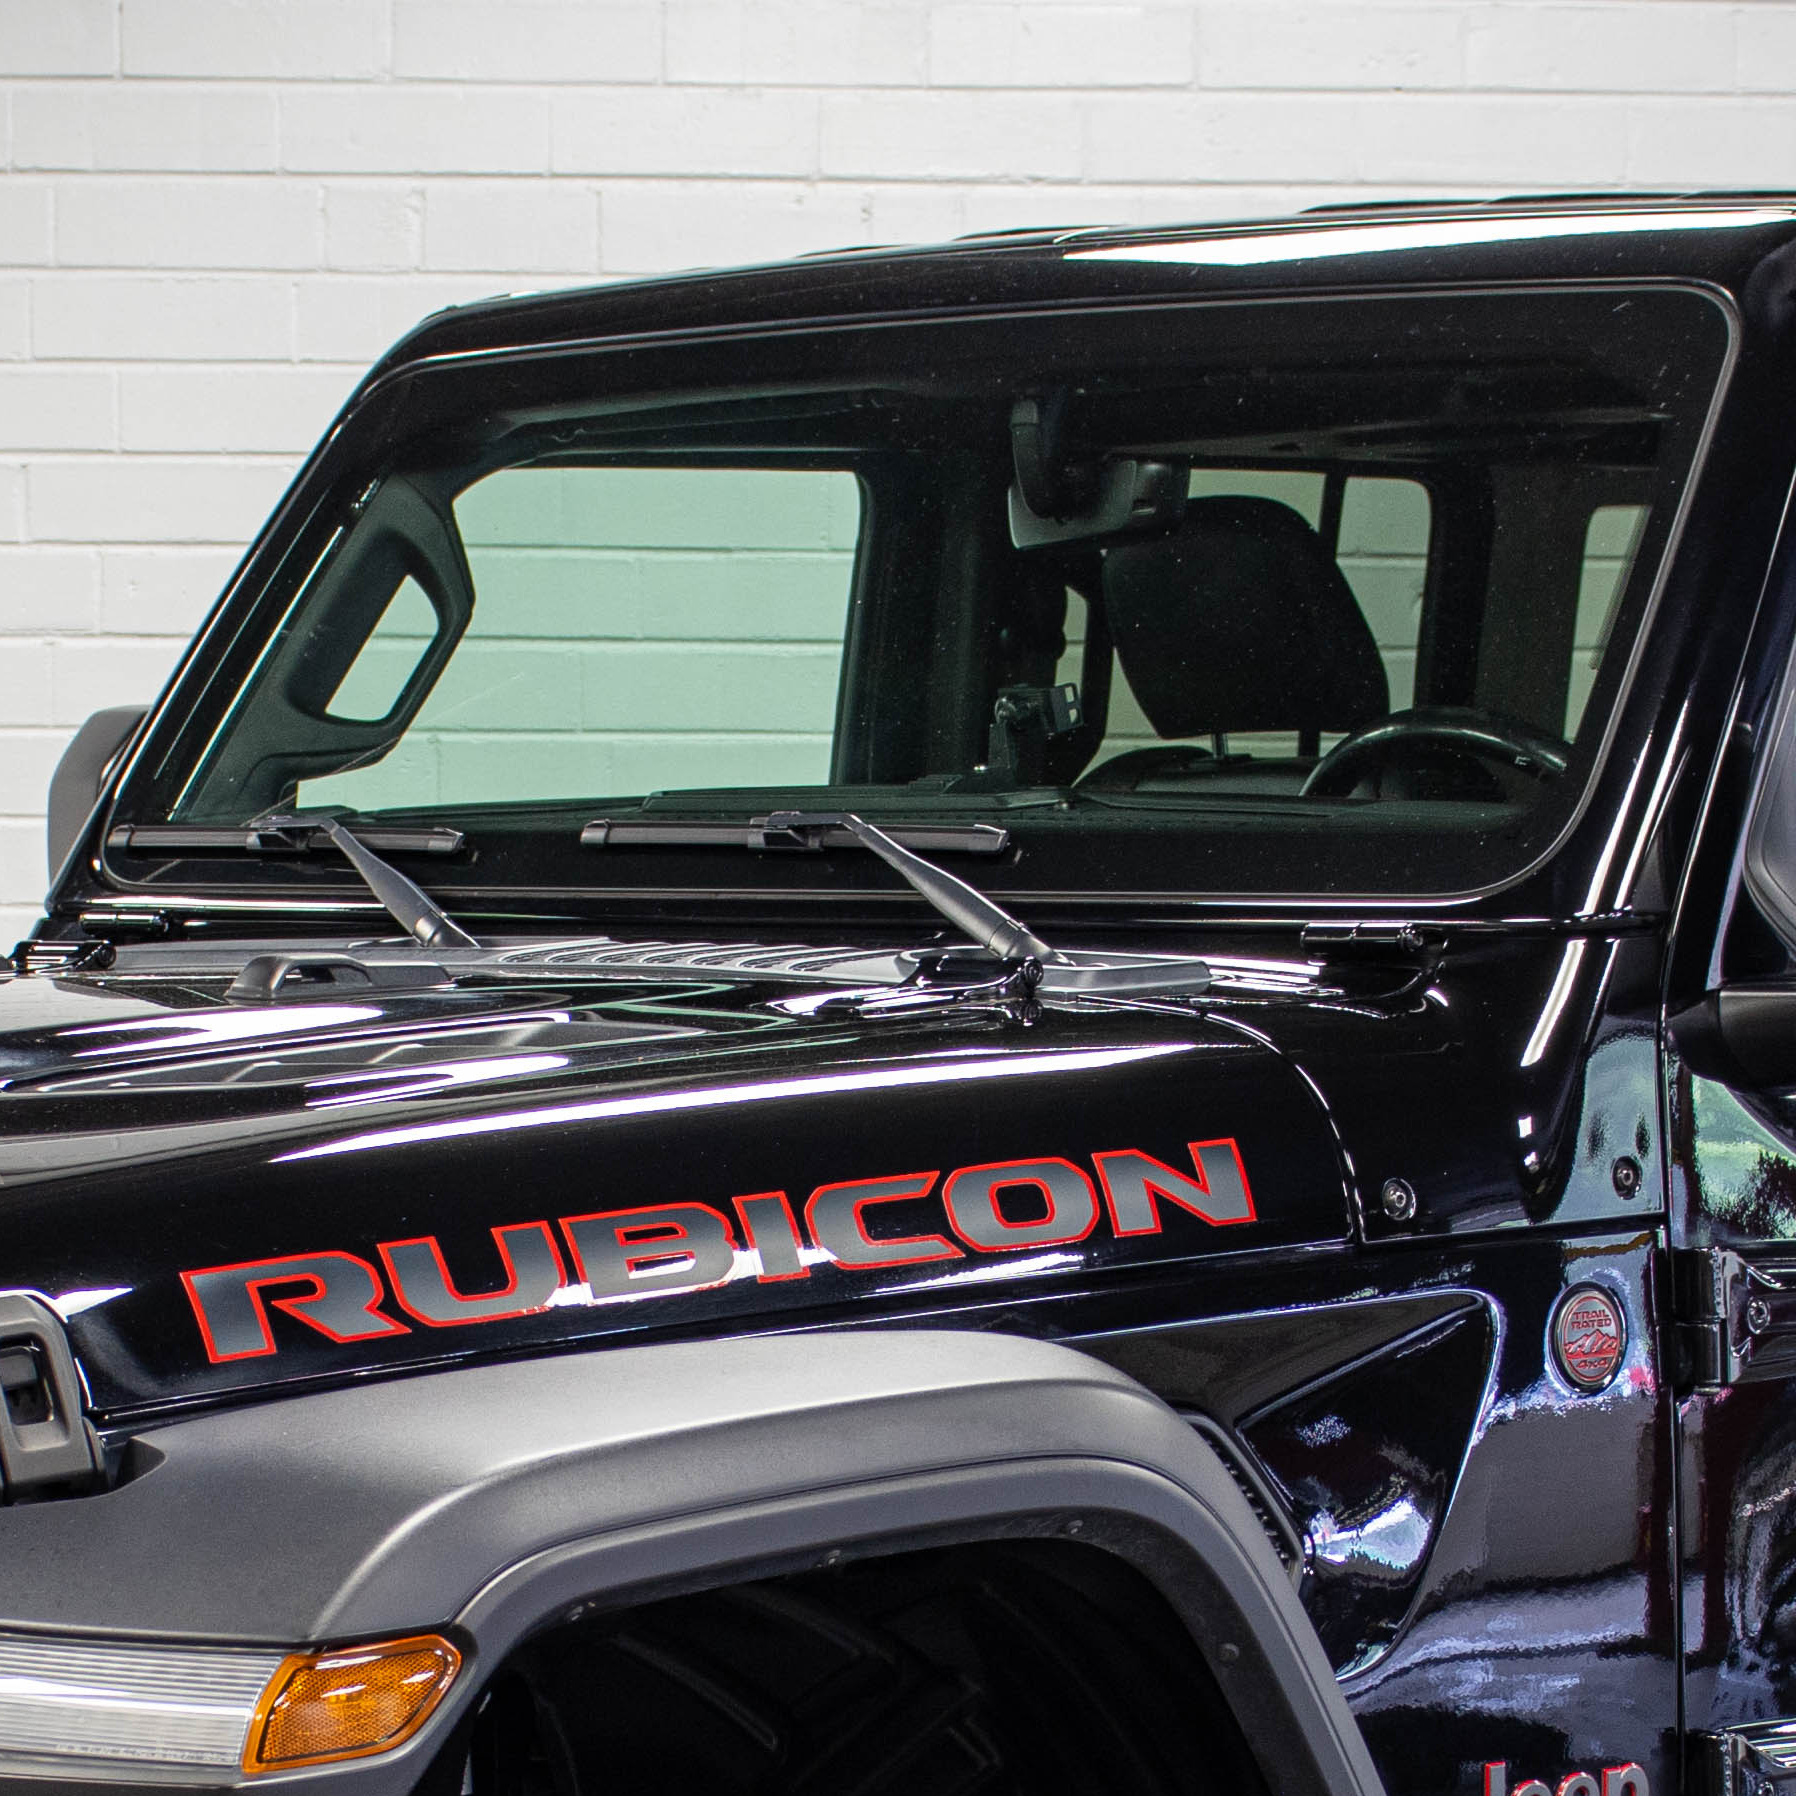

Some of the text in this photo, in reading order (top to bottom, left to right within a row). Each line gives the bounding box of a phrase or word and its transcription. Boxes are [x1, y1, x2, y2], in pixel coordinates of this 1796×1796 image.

[180, 1137, 1258, 1364] RUBICON
[1574, 1309, 1609, 1320] TRAIL
[1571, 1318, 1611, 1329] RATED
